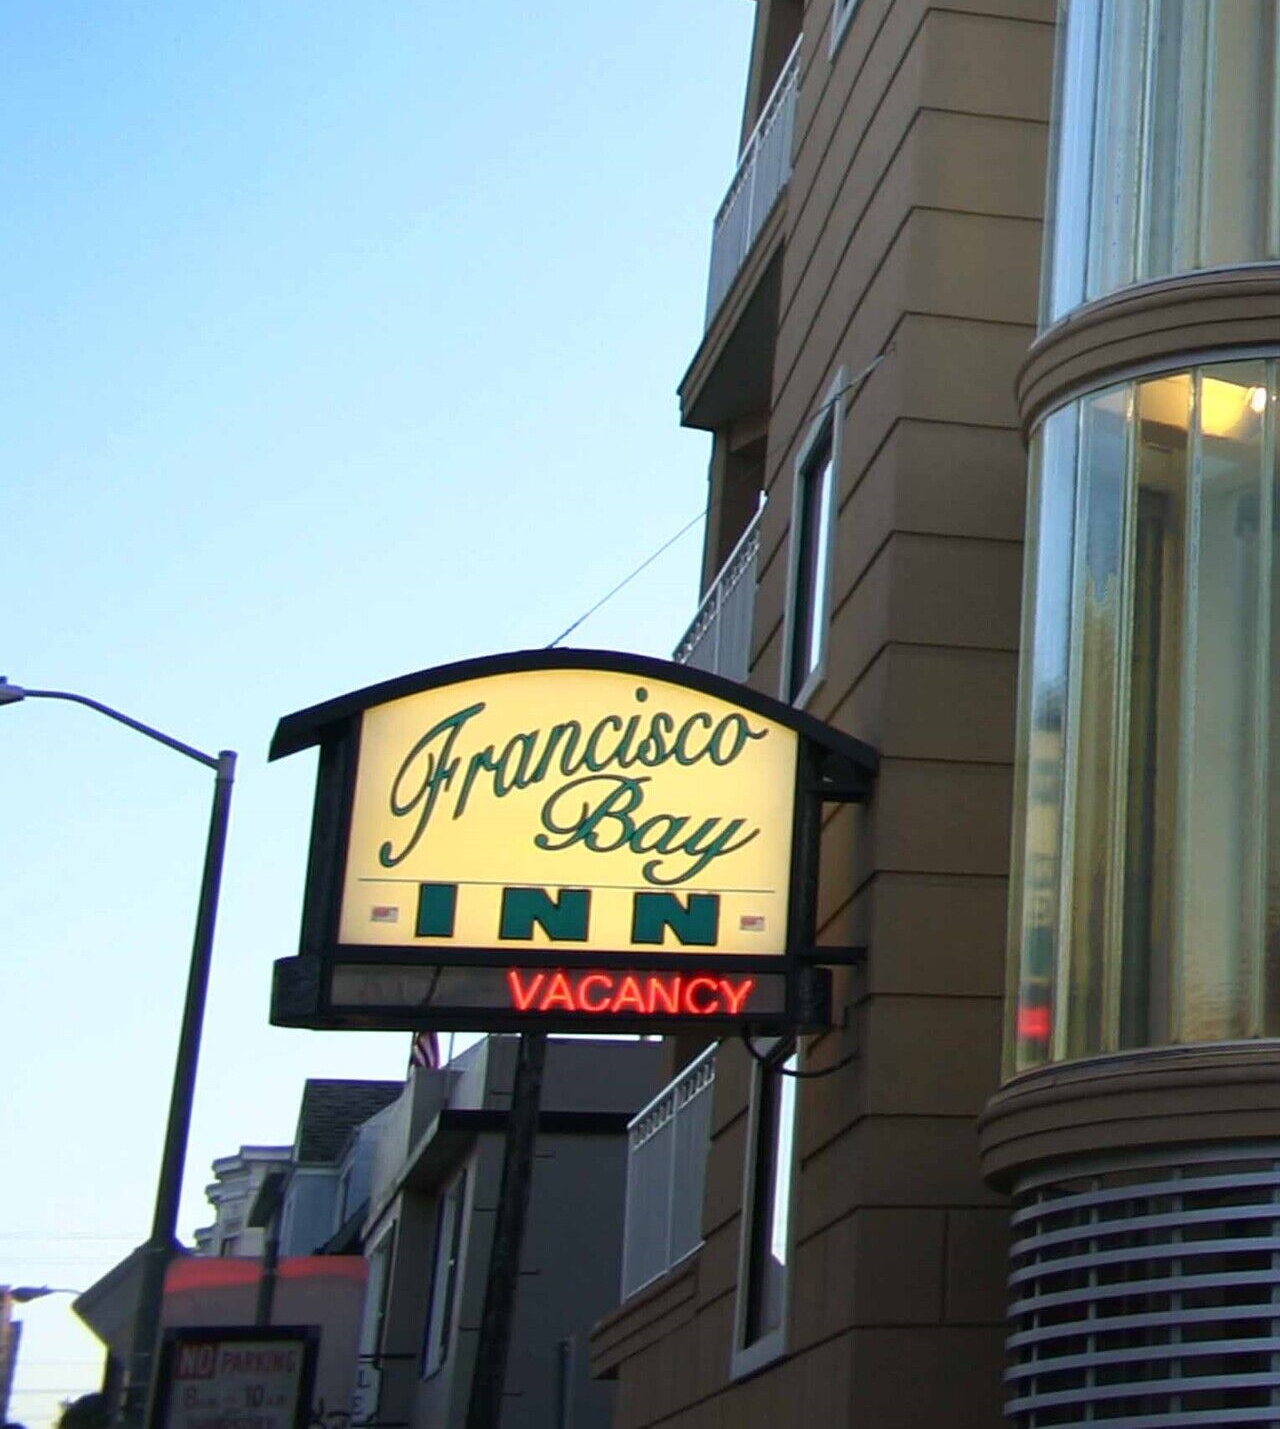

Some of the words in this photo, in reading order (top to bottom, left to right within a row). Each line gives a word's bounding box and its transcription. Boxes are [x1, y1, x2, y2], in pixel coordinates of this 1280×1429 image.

[379, 687, 769, 868] Francisco
[534, 773, 760, 886] Bay
[415, 882, 720, 946] INN
[508, 969, 754, 1015] VACANCY
